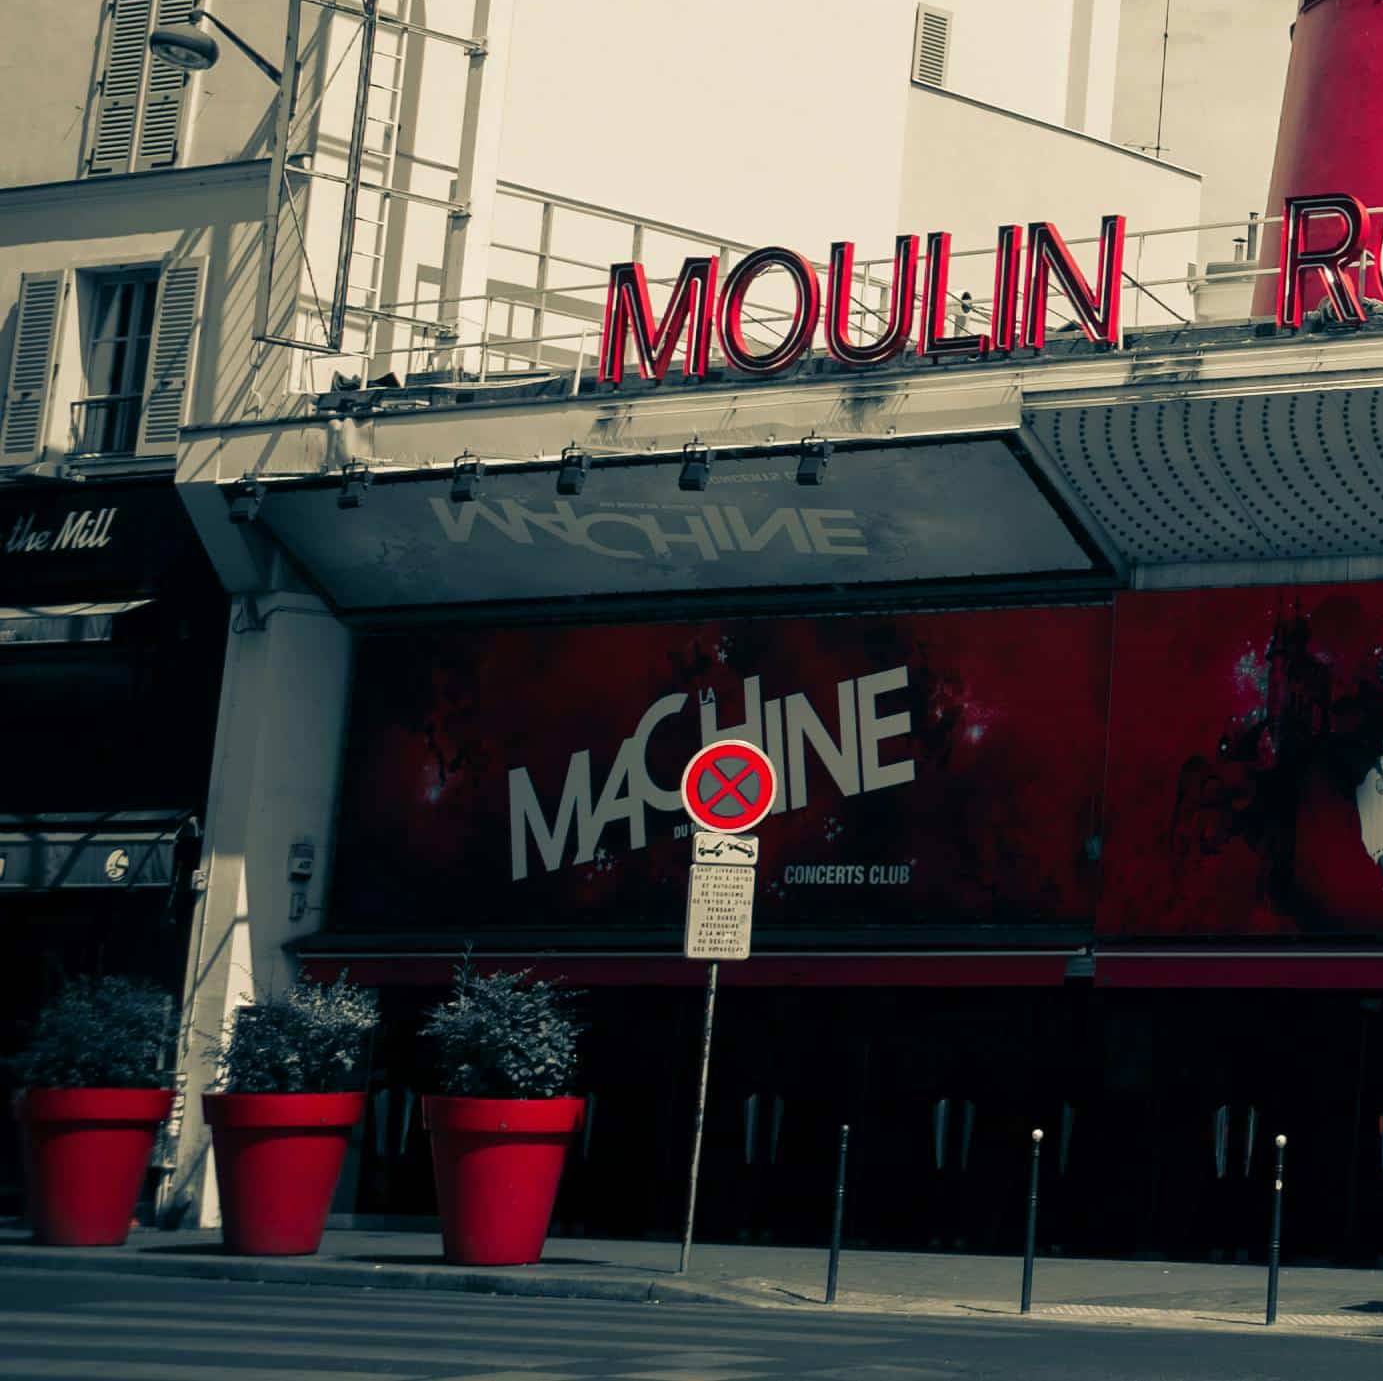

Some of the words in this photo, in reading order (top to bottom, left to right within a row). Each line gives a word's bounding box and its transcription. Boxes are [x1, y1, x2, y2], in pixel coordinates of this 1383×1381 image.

[600, 214, 1127, 383] MOULIN
[6, 513, 51, 552] the
[51, 507, 117, 551] Mill
[698, 687, 716, 704] LA
[508, 665, 916, 882] MACHINE
[784, 865, 865, 885] CONCERTS
[869, 865, 911, 884] CLUB
